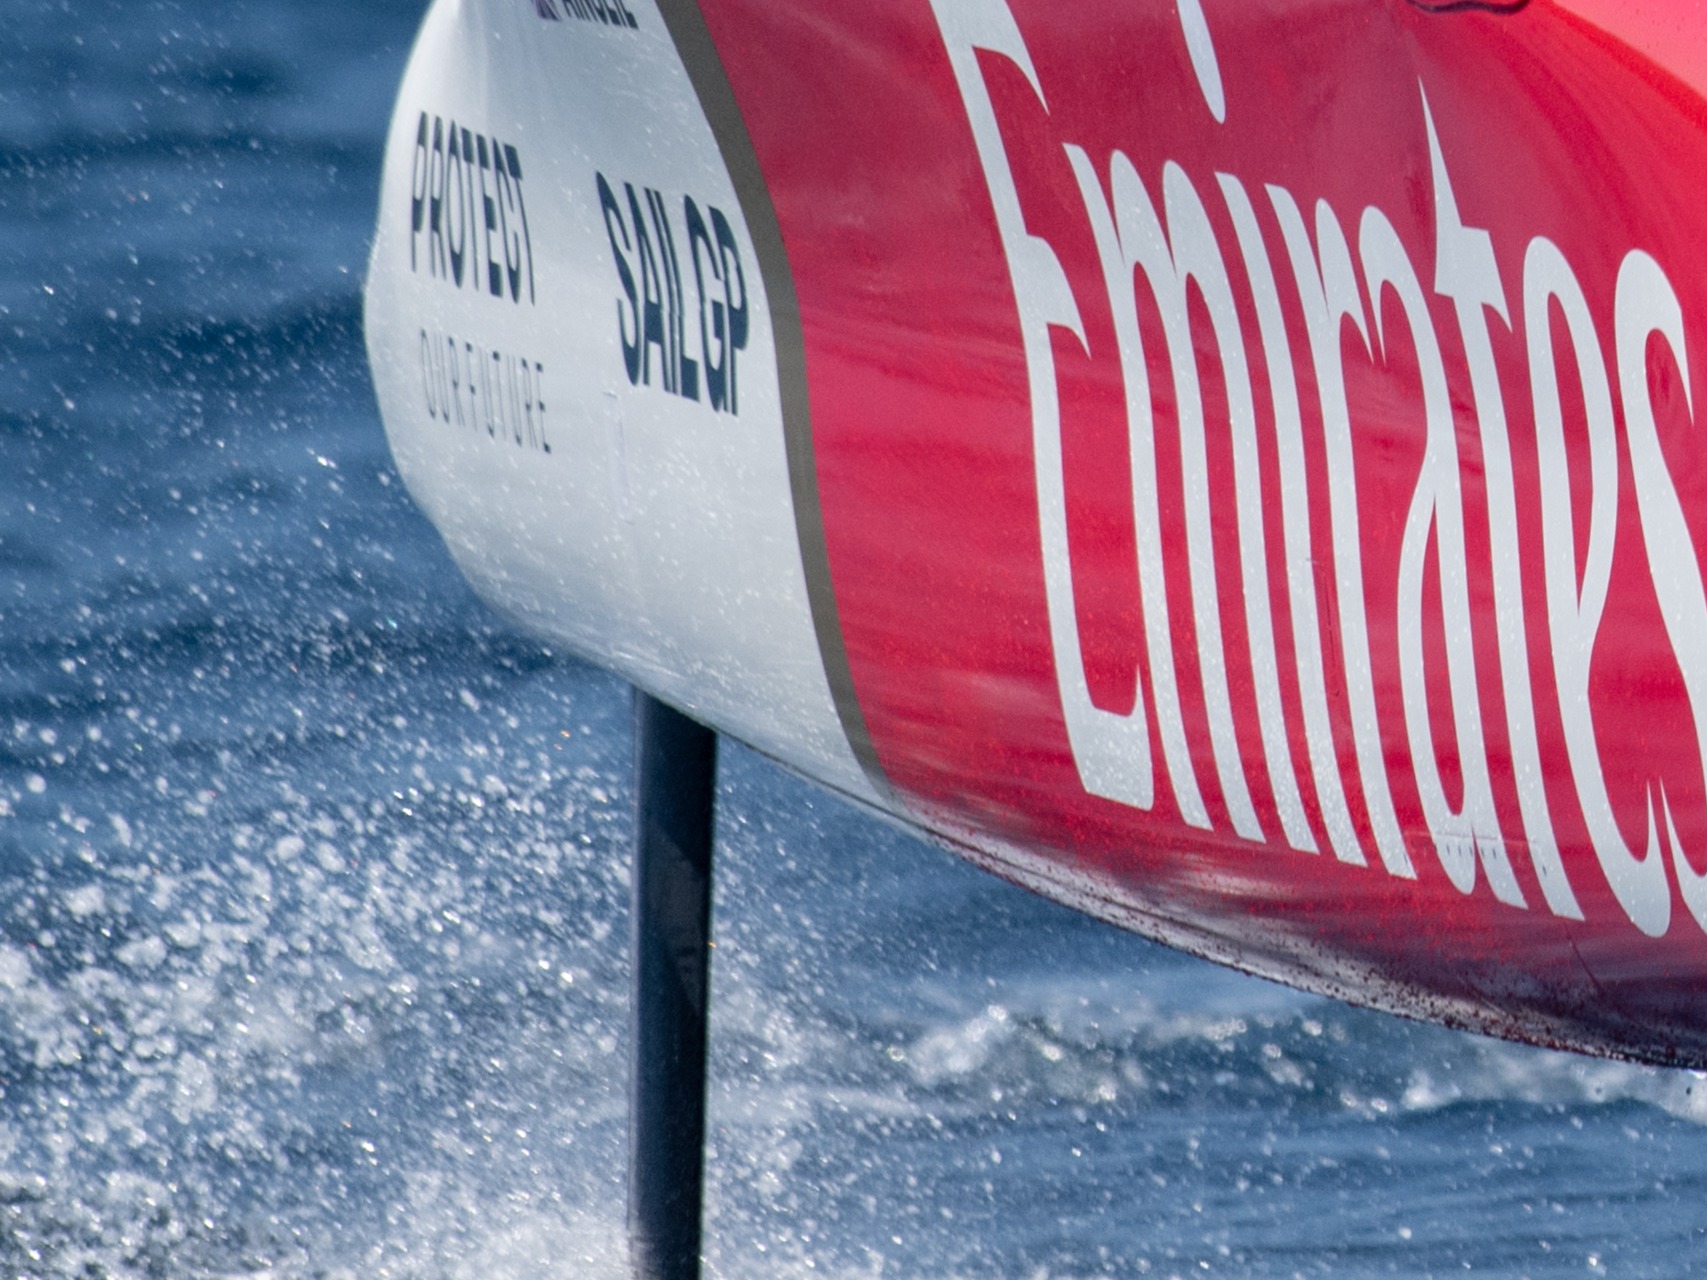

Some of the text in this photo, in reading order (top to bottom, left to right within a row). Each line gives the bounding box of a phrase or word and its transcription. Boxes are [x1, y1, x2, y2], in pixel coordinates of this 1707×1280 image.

[410, 110, 536, 306] PROTECT
[595, 170, 749, 418] SAILGP
[419, 326, 553, 456] OUR FUTURE
